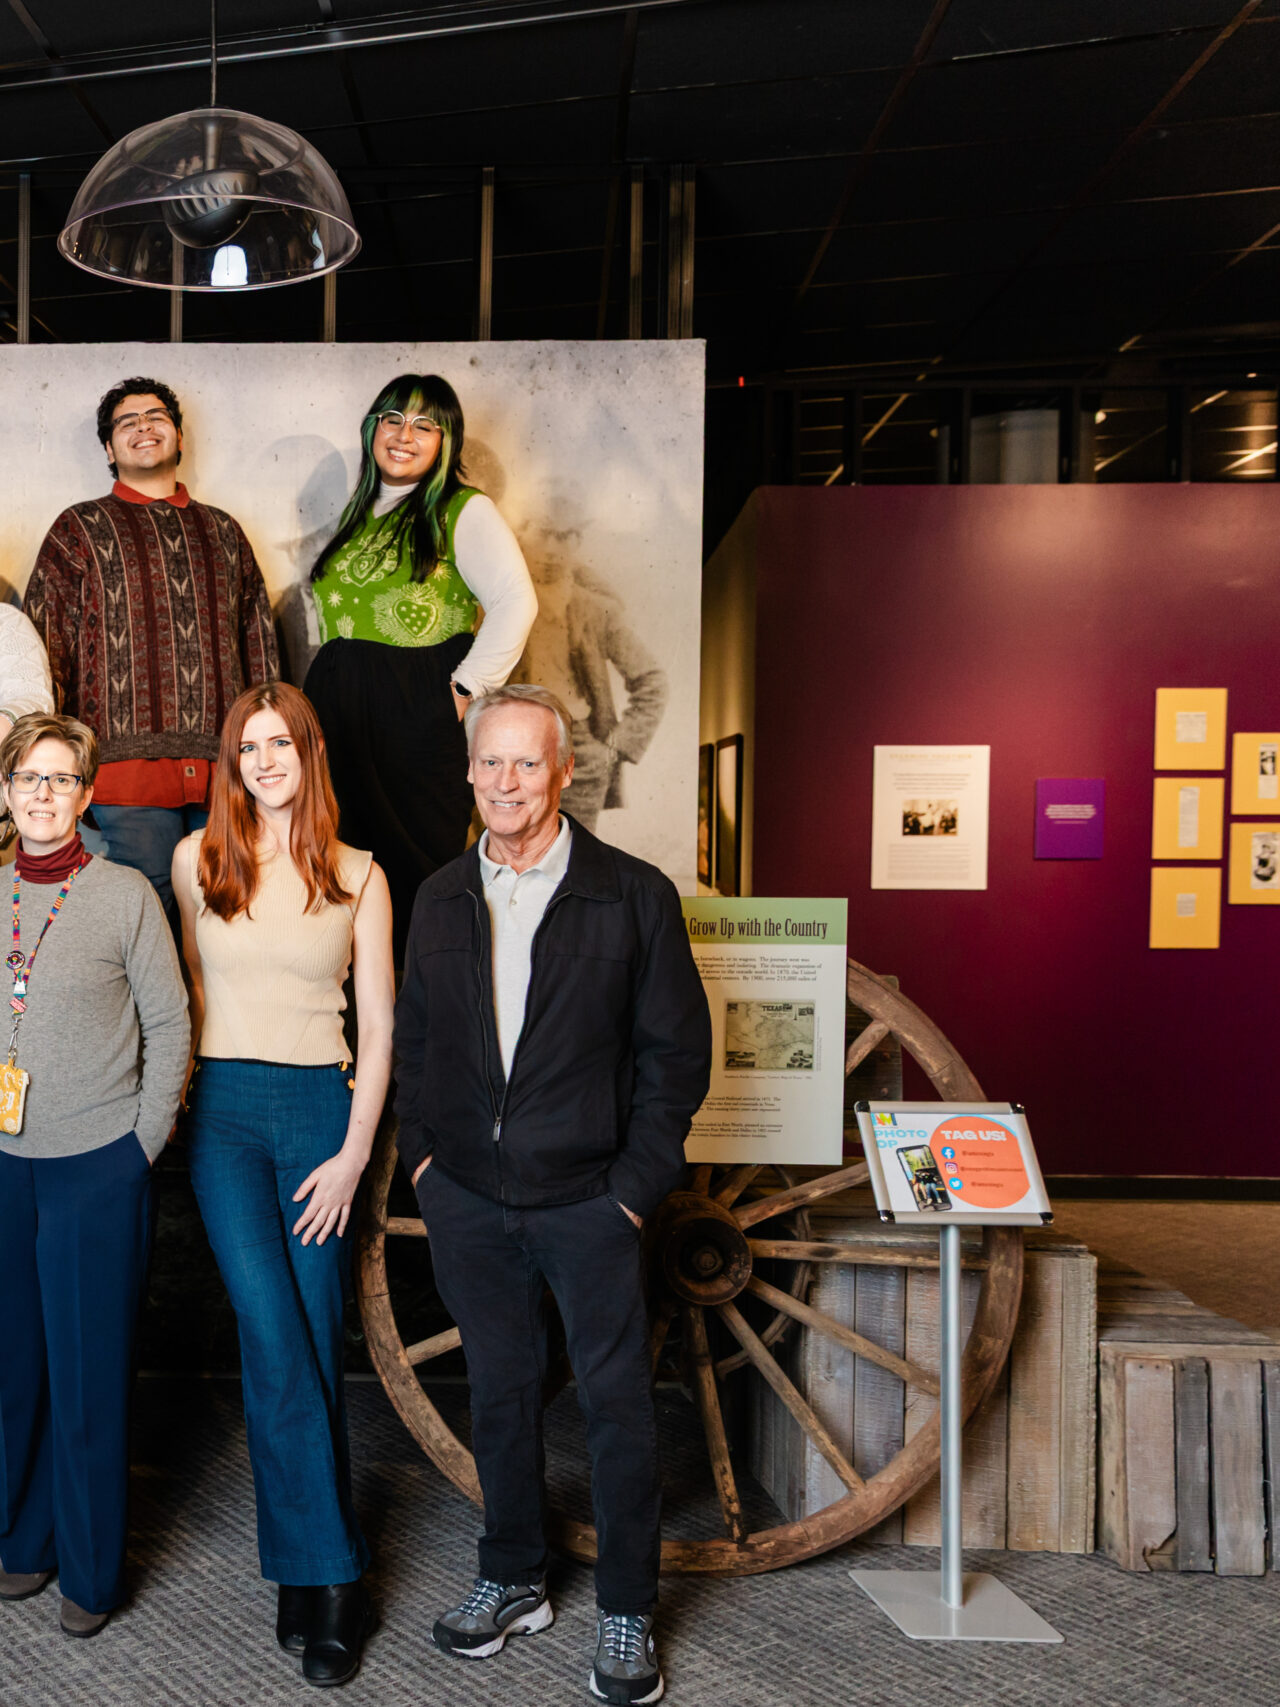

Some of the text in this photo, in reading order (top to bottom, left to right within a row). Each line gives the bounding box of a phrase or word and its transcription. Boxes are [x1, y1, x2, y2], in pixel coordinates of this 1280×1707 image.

[689, 917, 828, 940] Grow Up with the Country
[874, 1129, 928, 1138] PHOTO
[940, 1130, 1007, 1141] TAG US!
[877, 1139, 898, 1148] OP
